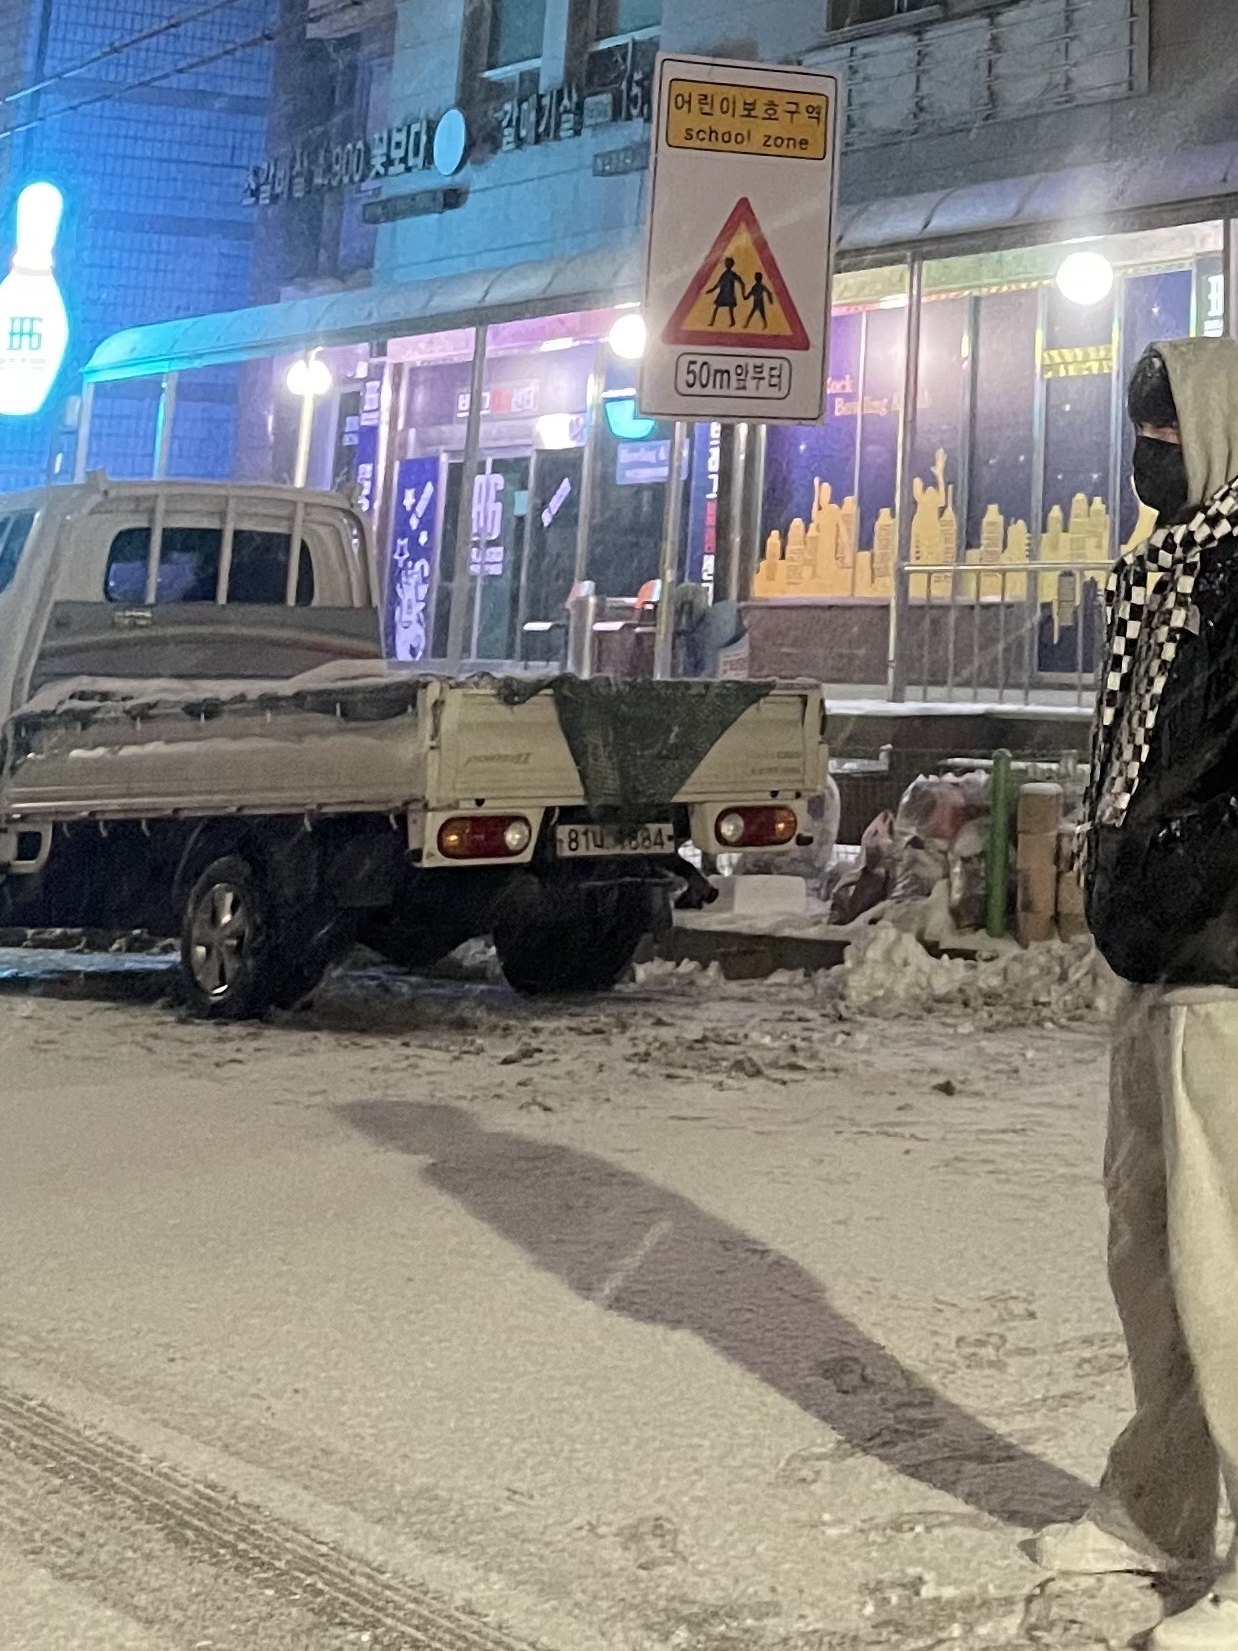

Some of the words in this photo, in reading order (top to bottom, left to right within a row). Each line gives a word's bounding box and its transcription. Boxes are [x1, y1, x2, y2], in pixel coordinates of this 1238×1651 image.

[674, 92, 822, 124] 어린이보호구역
[684, 126, 752, 146] school
[763, 133, 810, 151] zone
[685, 359, 783, 393] 50m앞부터
